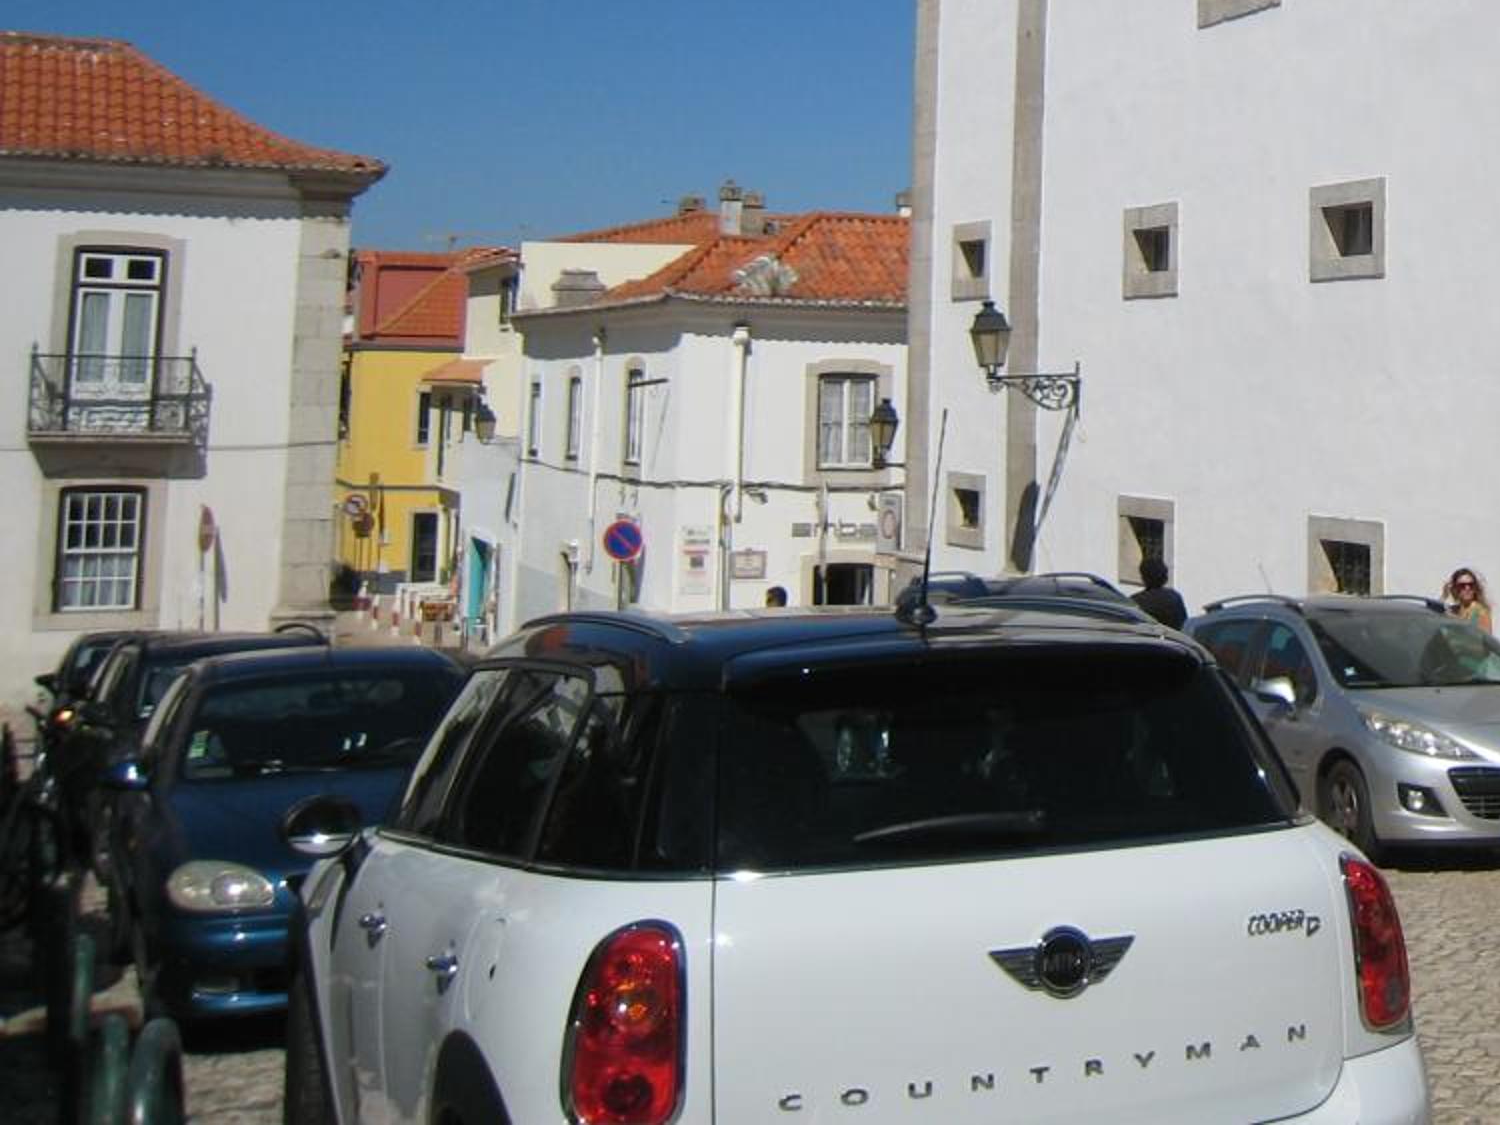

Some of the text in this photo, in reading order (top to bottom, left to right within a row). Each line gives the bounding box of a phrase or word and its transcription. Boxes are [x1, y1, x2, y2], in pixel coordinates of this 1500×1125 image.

[1248, 909, 1321, 937] COOPER D
[778, 1023, 1307, 1113] COUNTRYMAN
